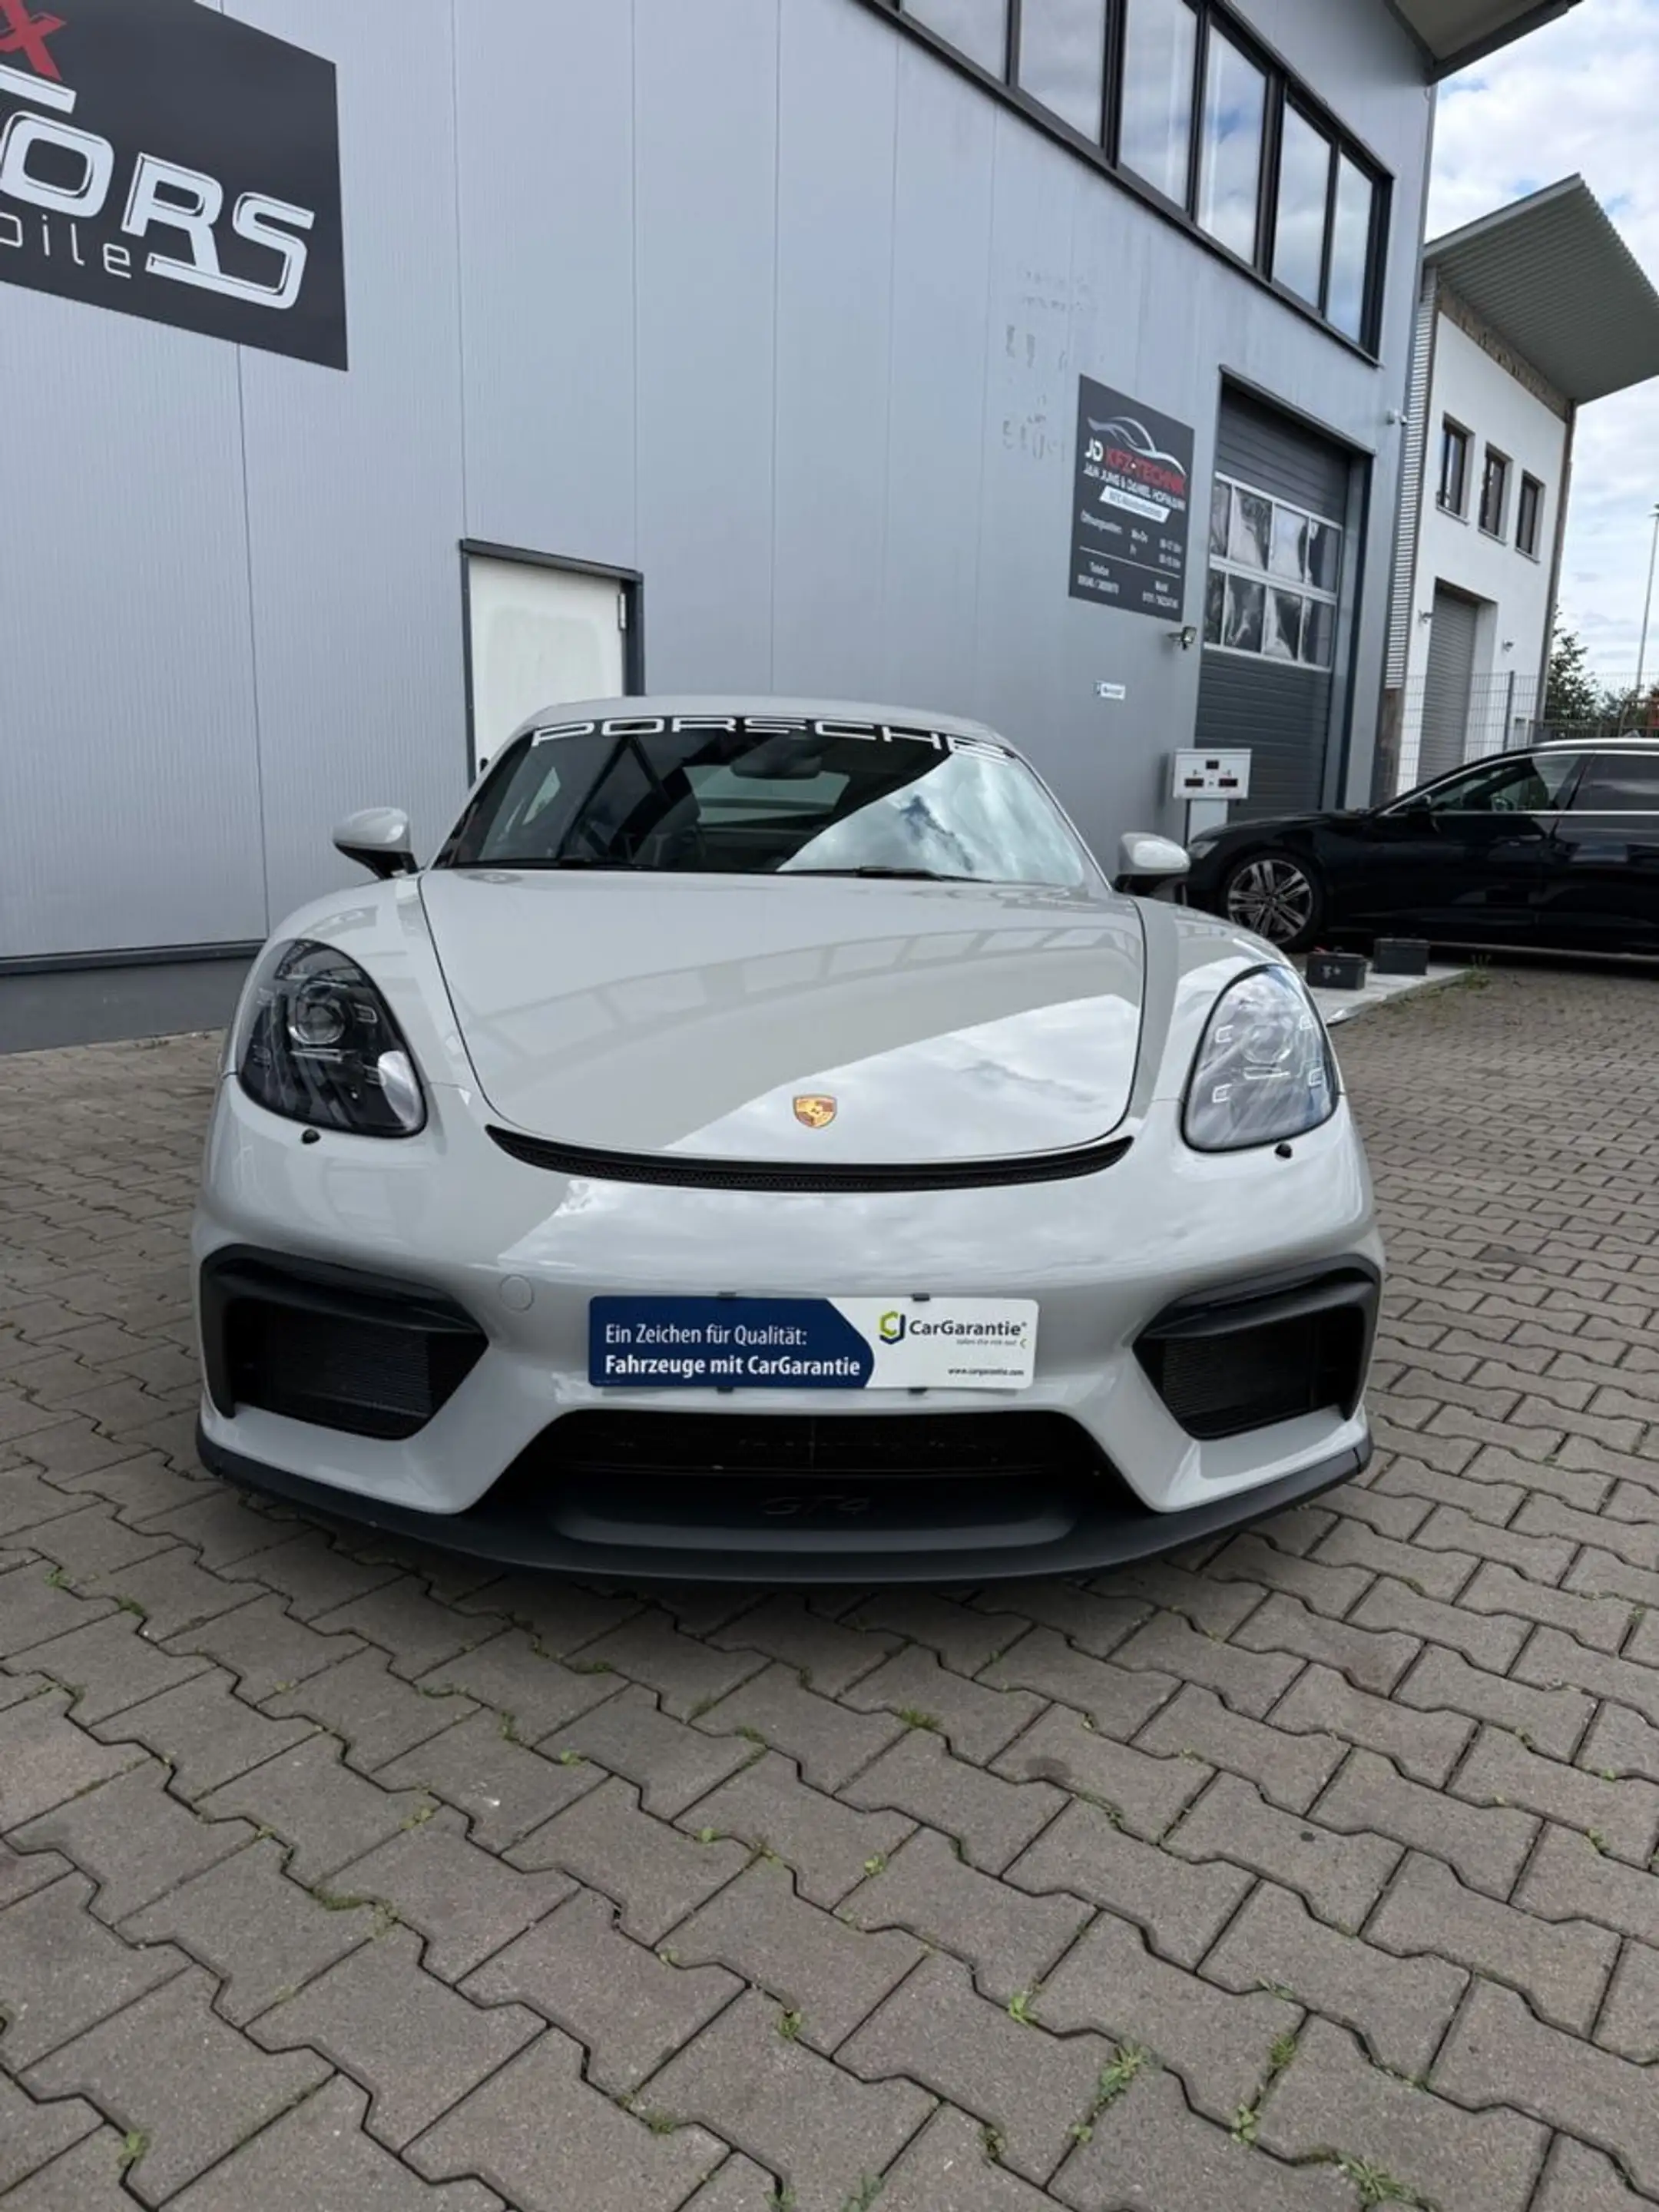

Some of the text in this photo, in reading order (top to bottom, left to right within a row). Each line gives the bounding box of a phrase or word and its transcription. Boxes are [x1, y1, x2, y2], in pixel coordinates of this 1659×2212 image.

[1084, 437, 1104, 462] JD
[531, 716, 1008, 766] PORSCHE
[605, 1324, 808, 1346] Ein Zeichen für Qualität:
[605, 1354, 861, 1378] Fahrzeuge mit CarGarantie
